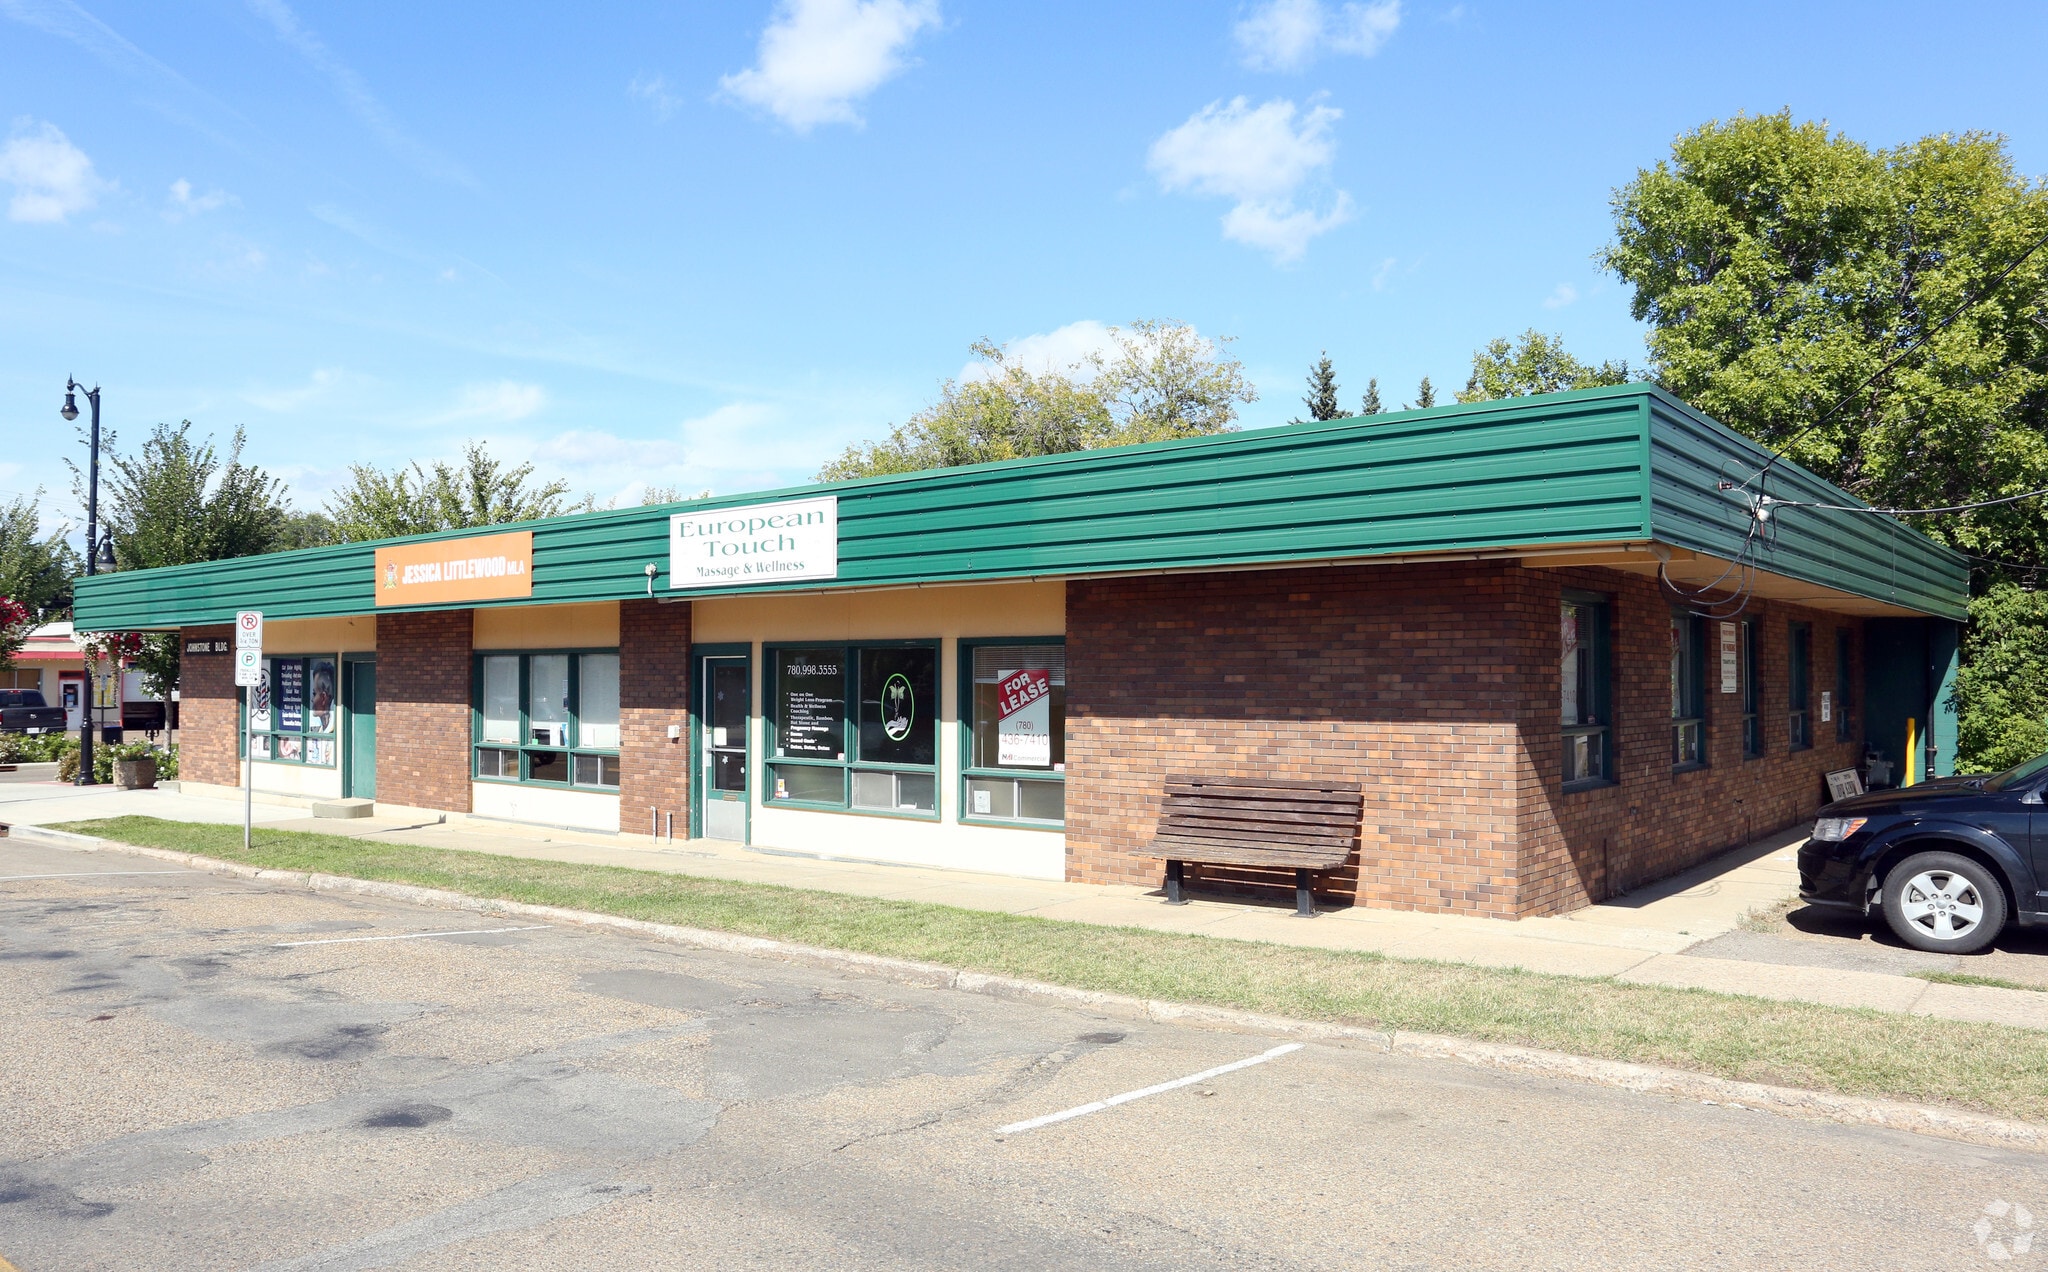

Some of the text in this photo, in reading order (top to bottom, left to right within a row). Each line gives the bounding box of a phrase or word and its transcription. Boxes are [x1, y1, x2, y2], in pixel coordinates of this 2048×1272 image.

[679, 510, 825, 538] European
[703, 534, 796, 557] Touch
[402, 556, 525, 584] JESSICA LITTLEWOOD MLA
[696, 560, 805, 578] Massage & Wellness
[787, 665, 837, 675] 780.998.3555
[1004, 673, 1031, 695] FOR
[1000, 678, 1049, 715] LEASE
[1015, 721, 1034, 731] (780)
[1001, 734, 1049, 746] 436-7410
